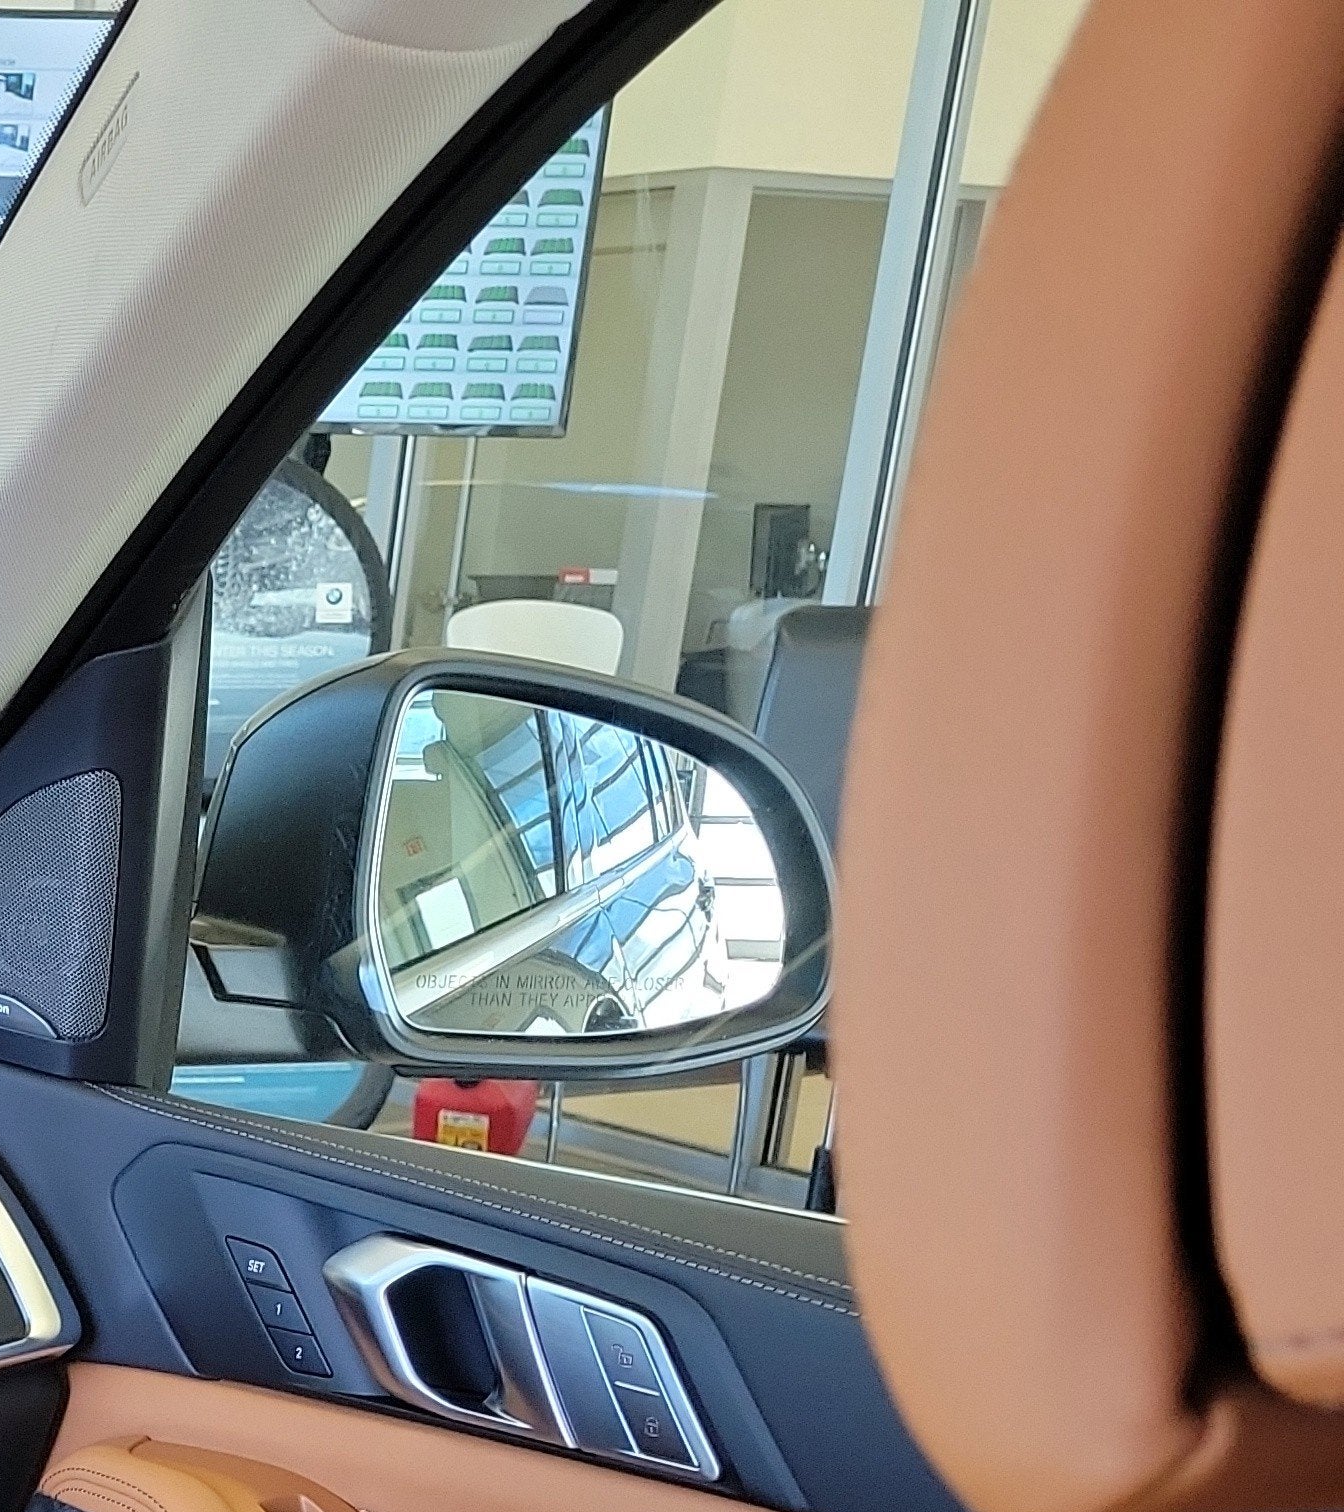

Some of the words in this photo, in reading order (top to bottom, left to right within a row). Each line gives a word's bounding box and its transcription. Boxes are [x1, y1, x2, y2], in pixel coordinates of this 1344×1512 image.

[496, 975, 510, 989] IN
[517, 975, 576, 990] MIRROR
[470, 993, 511, 1007] THAN
[520, 993, 559, 1007] THEY
[247, 1259, 265, 1274] SET
[275, 1302, 282, 1316] 1
[295, 1346, 303, 1360] 2
